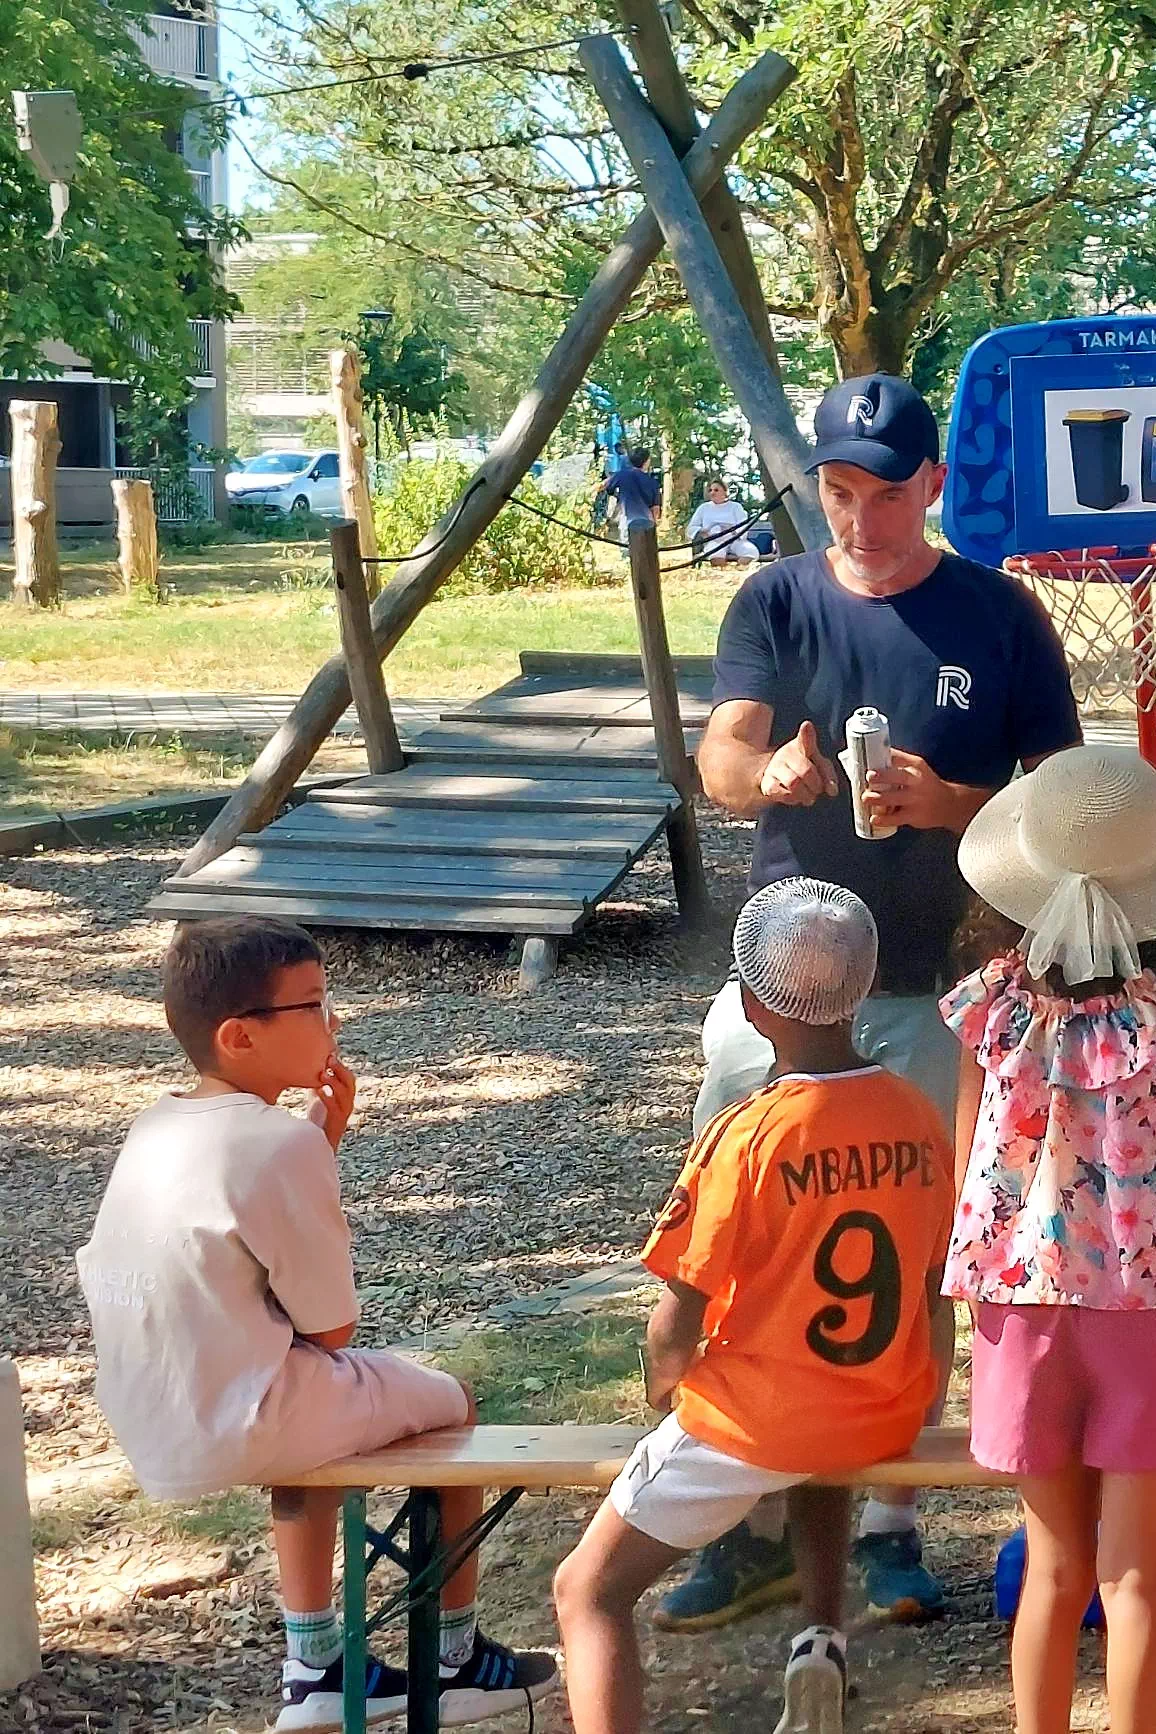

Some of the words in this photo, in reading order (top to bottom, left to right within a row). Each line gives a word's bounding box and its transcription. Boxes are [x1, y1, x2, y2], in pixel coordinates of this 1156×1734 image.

[847, 395, 873, 426] R
[936, 665, 972, 710] R
[806, 1210, 901, 1366] 9
